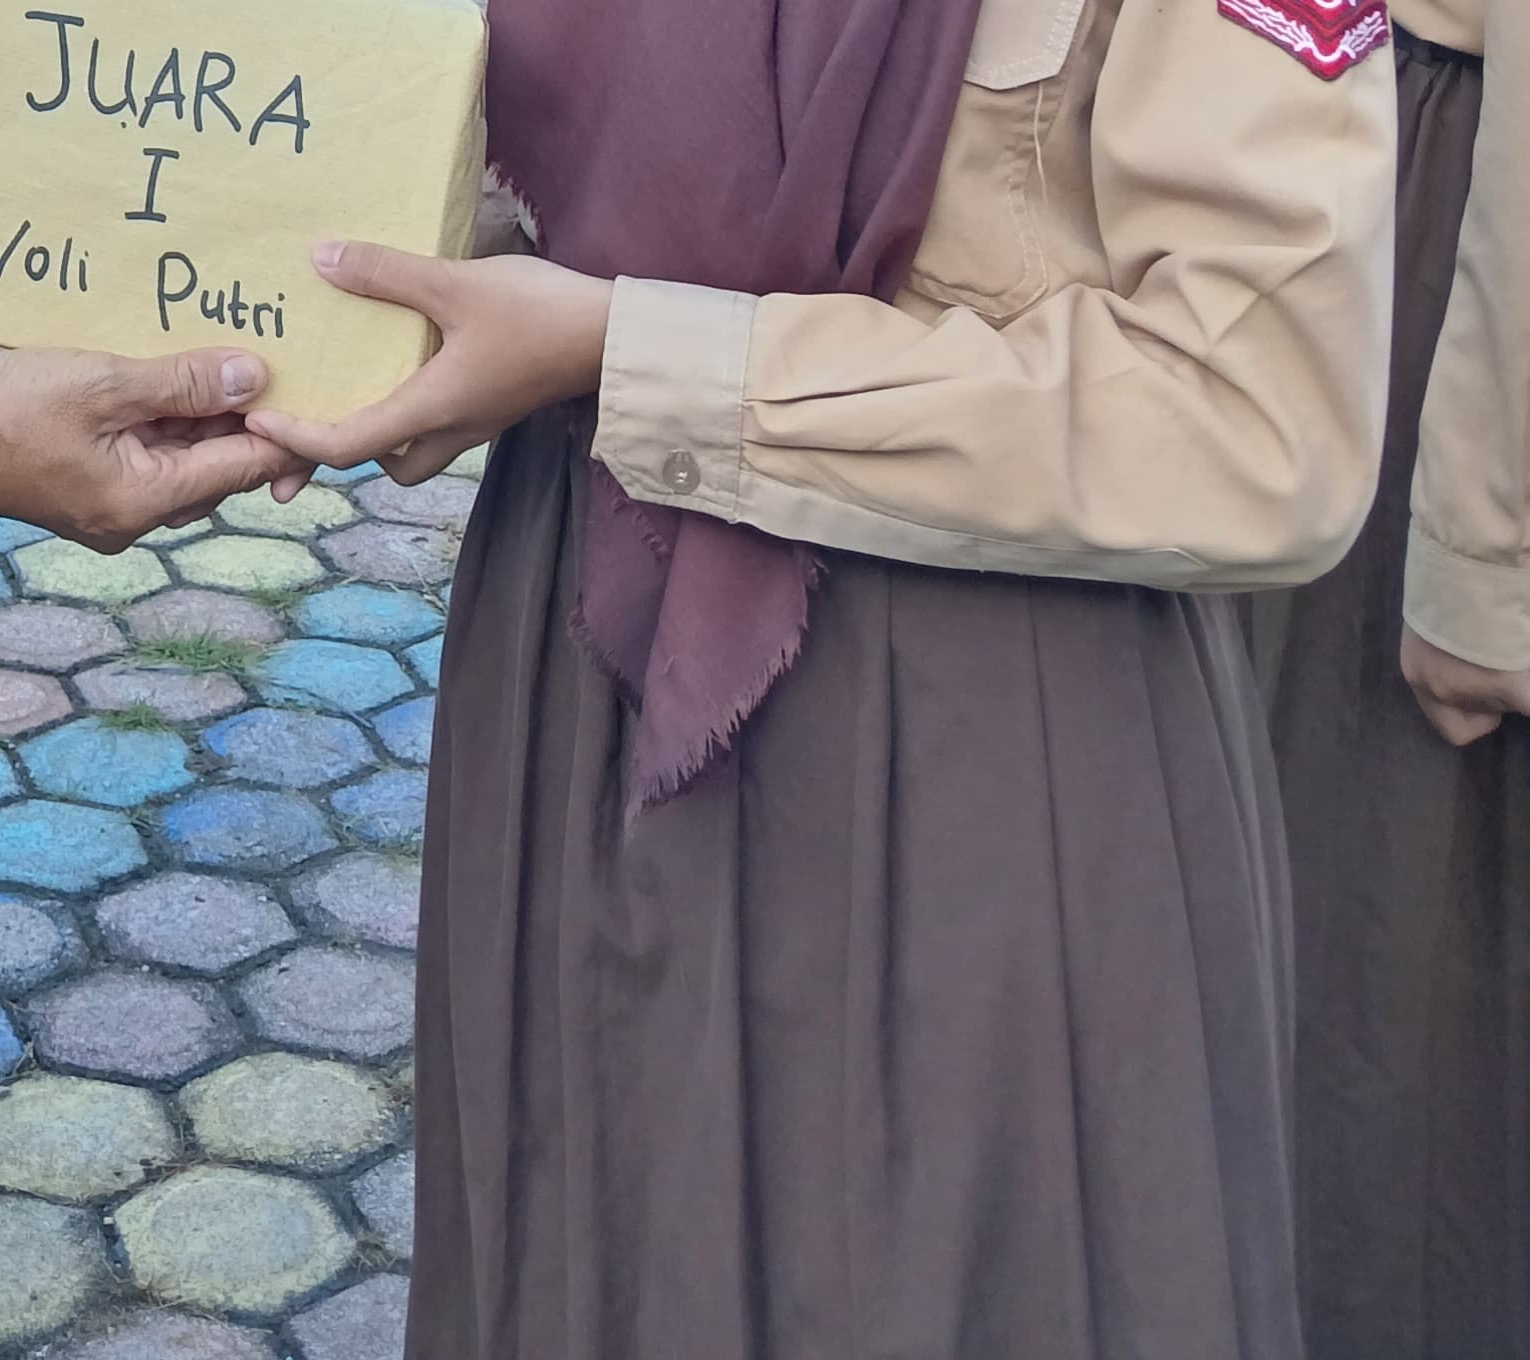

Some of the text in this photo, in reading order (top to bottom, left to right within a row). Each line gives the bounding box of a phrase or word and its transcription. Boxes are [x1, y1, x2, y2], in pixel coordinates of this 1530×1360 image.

[24, 9, 311, 155] JUARA
[124, 146, 181, 225] I
[157, 250, 286, 339] Putri
